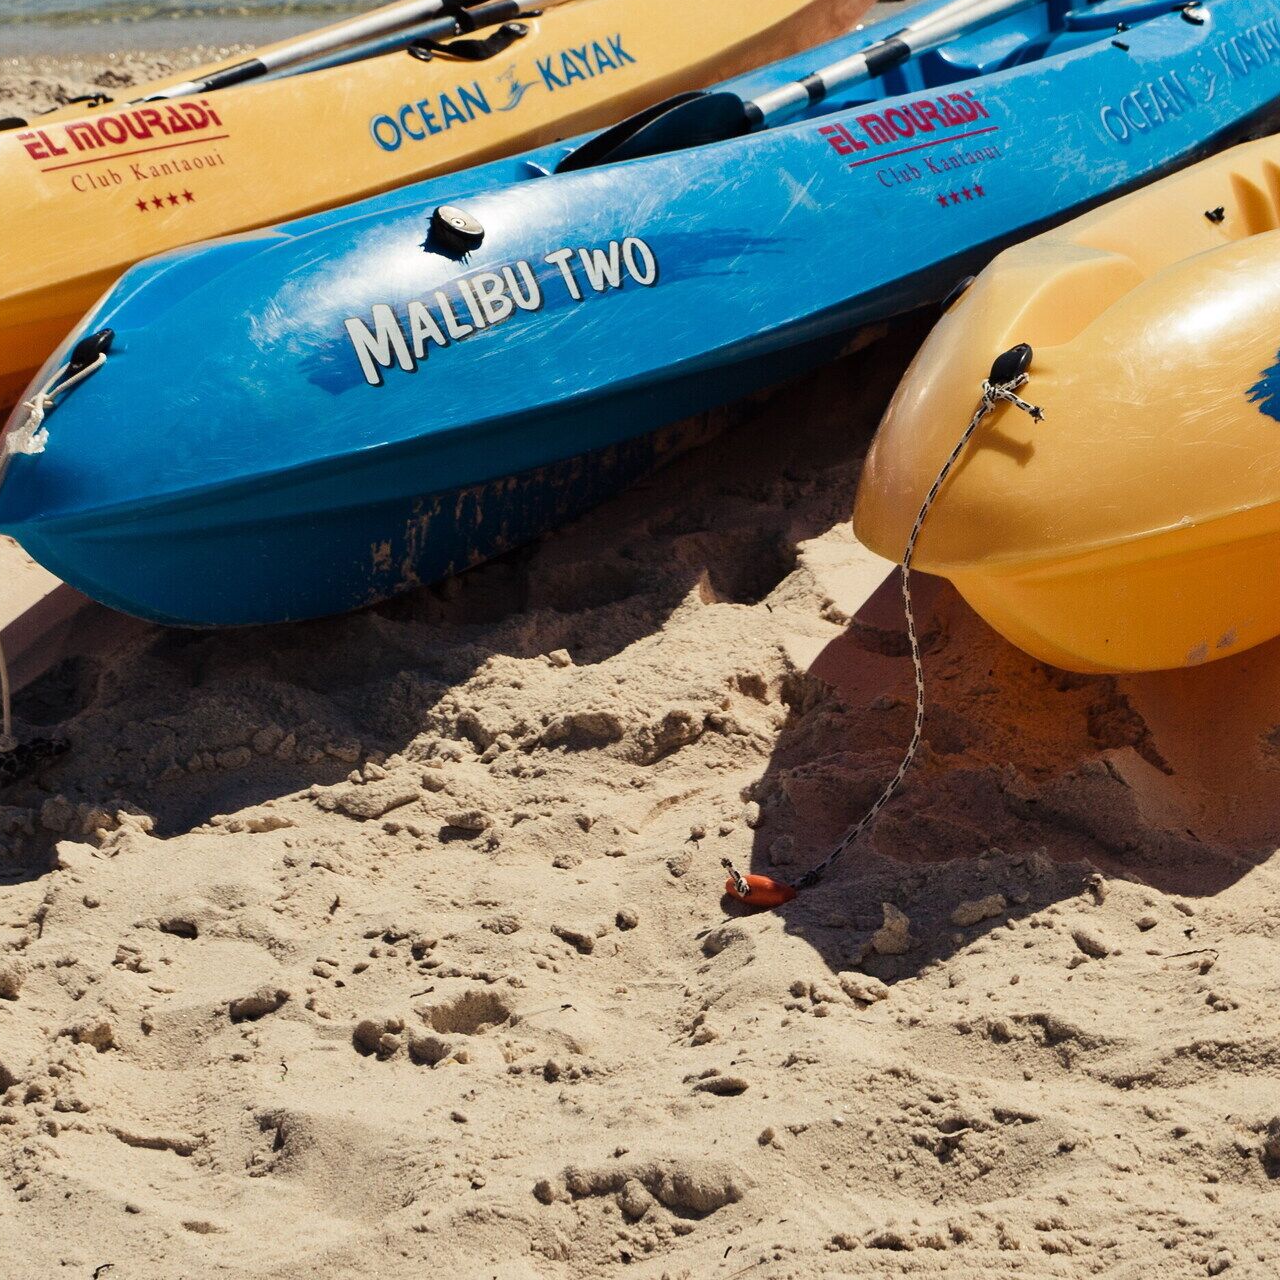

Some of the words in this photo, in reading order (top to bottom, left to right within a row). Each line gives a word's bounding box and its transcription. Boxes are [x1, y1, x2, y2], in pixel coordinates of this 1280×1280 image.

[371, 81, 492, 152] OCEAN
[536, 33, 636, 91] KAYAK
[1100, 70, 1197, 144] OCEAN
[17, 129, 68, 160] EL
[818, 122, 869, 156] EL
[71, 168, 122, 193] Club
[129, 148, 226, 181] Kantaoui
[875, 162, 921, 188] Club
[923, 144, 1003, 175] Kantaoui
[344, 260, 545, 388] MALIBU
[544, 236, 659, 302] TWO
